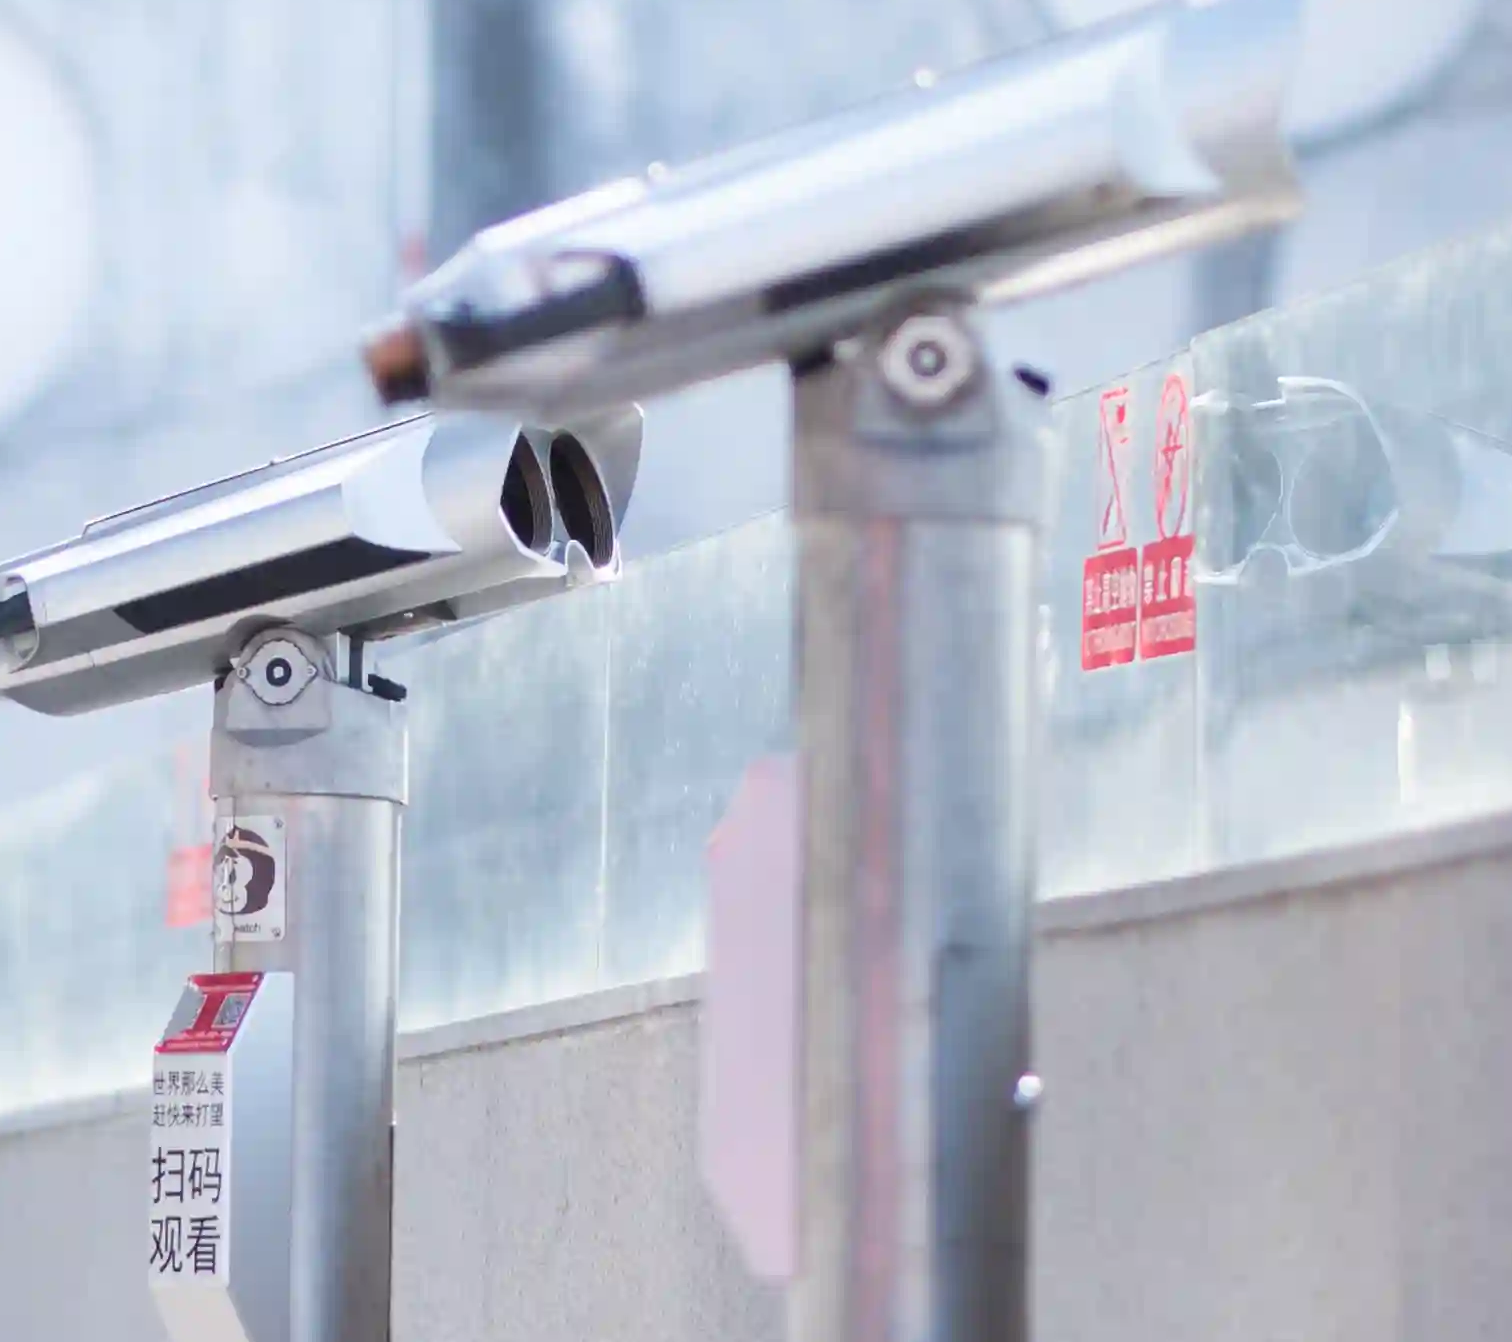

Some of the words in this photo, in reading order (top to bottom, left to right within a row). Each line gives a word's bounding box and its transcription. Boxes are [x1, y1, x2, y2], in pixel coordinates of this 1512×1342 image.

[152, 1070, 225, 1096] 世界那么美
[153, 1102, 224, 1127] 赶快来打望
[152, 1147, 222, 1203] 扫码
[150, 1215, 220, 1274] 观看
